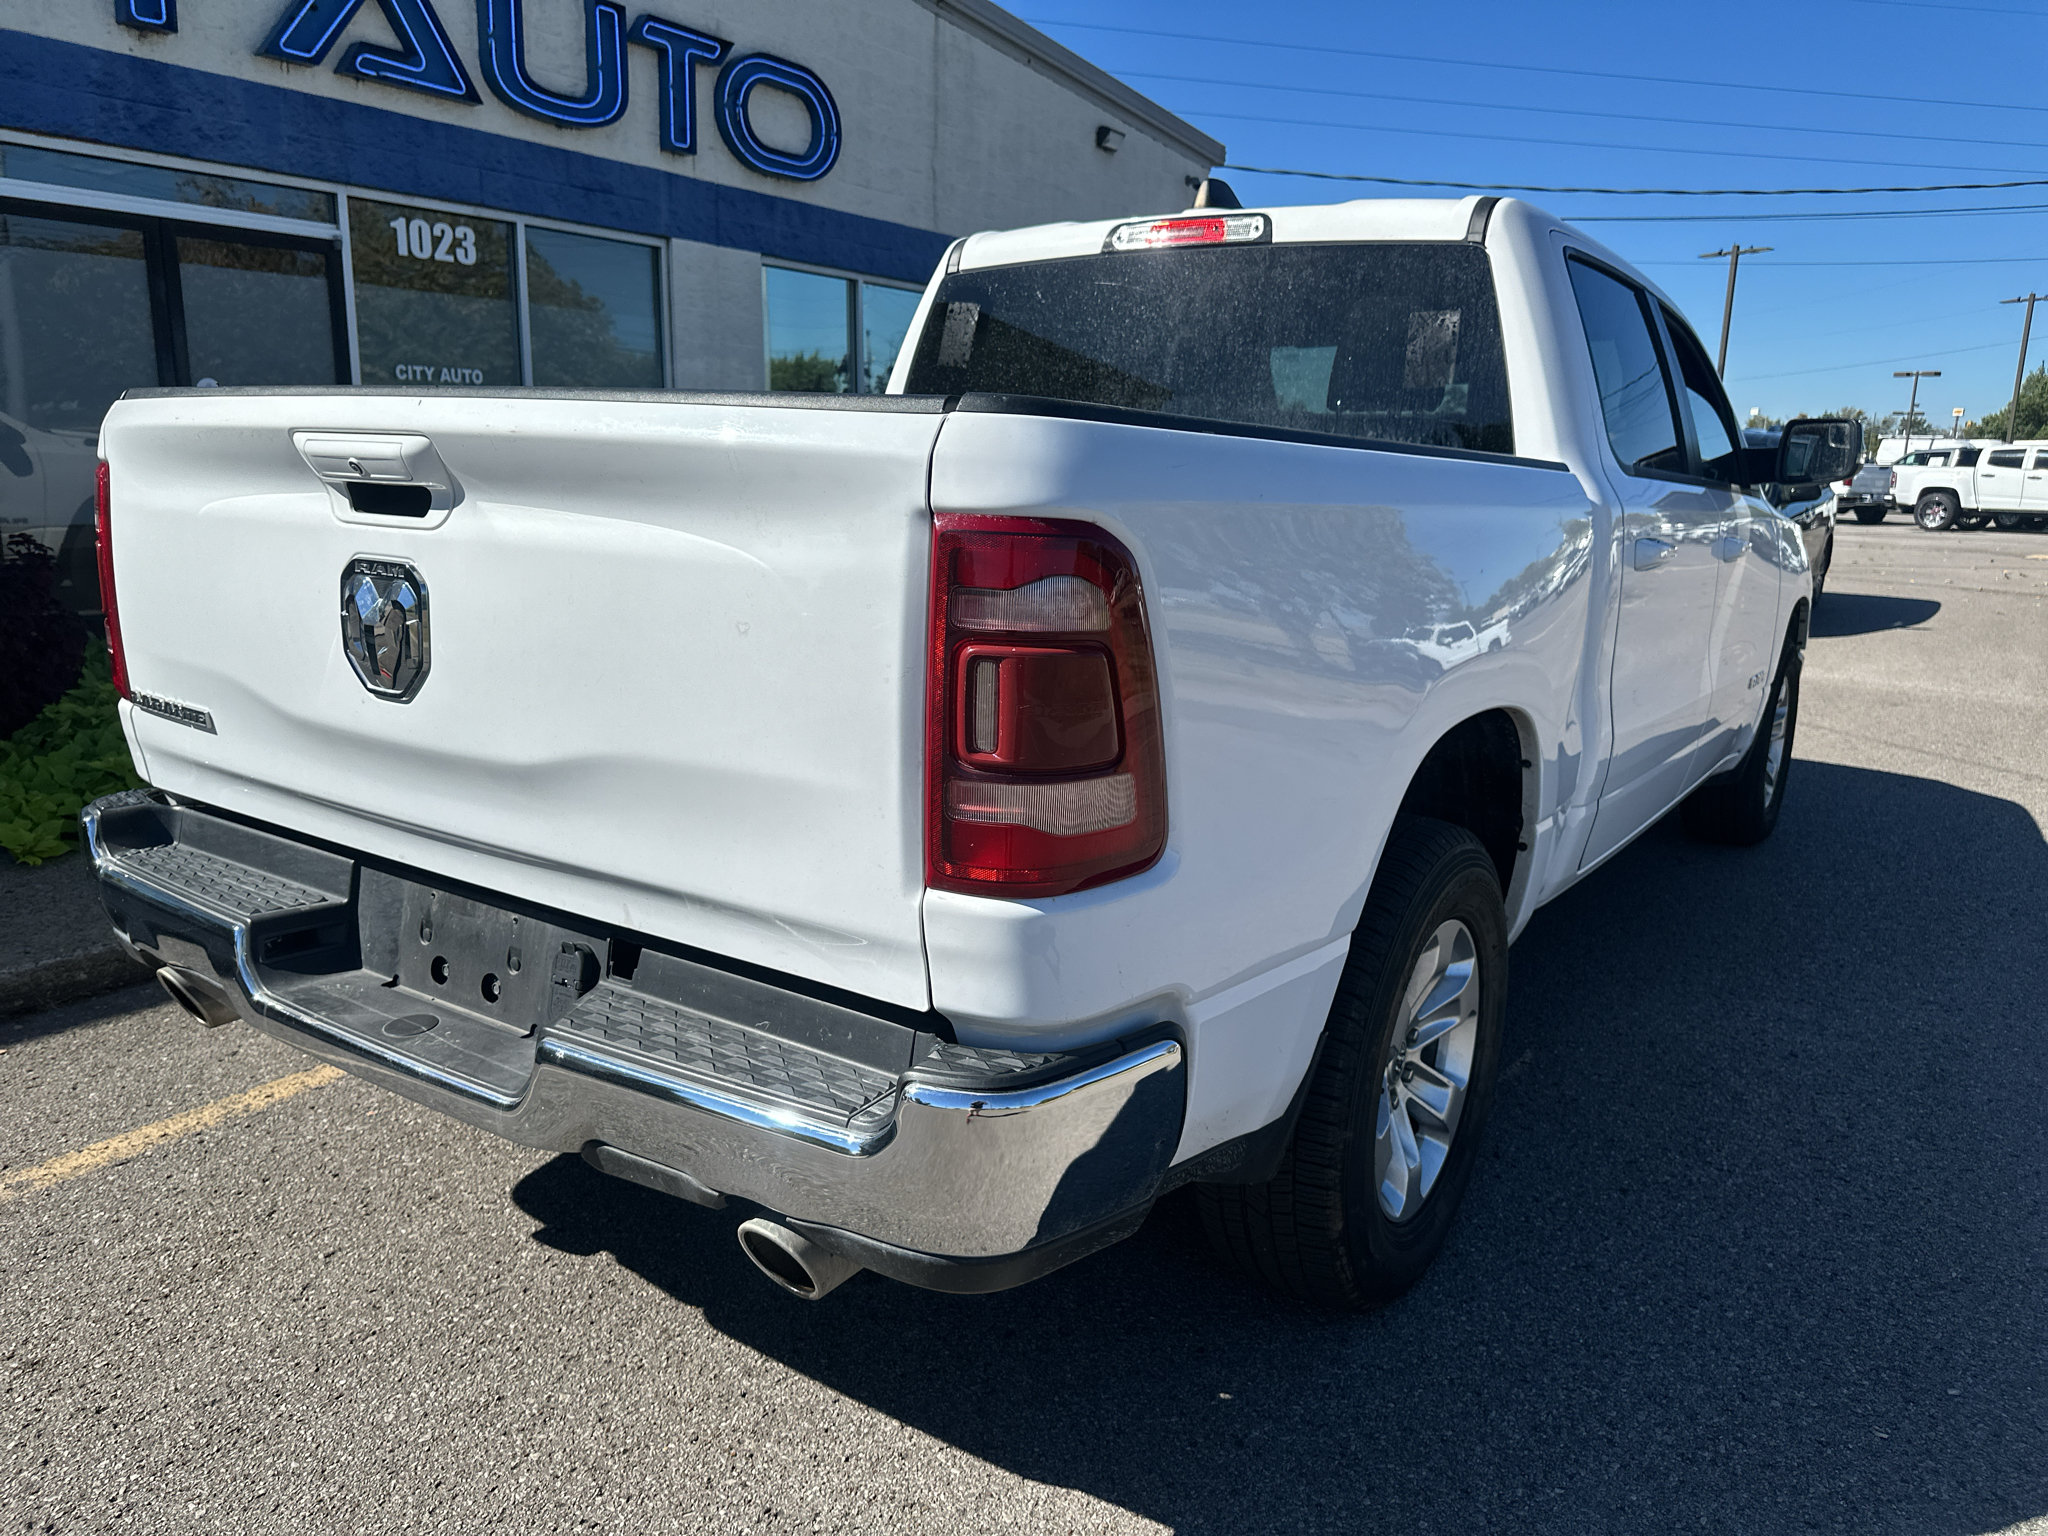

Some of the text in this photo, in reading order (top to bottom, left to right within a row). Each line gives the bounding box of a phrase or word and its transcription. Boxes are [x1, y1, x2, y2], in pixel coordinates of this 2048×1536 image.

[255, 0, 843, 181] AUTO
[390, 217, 477, 266] 1023
[395, 364, 483, 385] CITY AUTO
[354, 560, 405, 578] RAM
